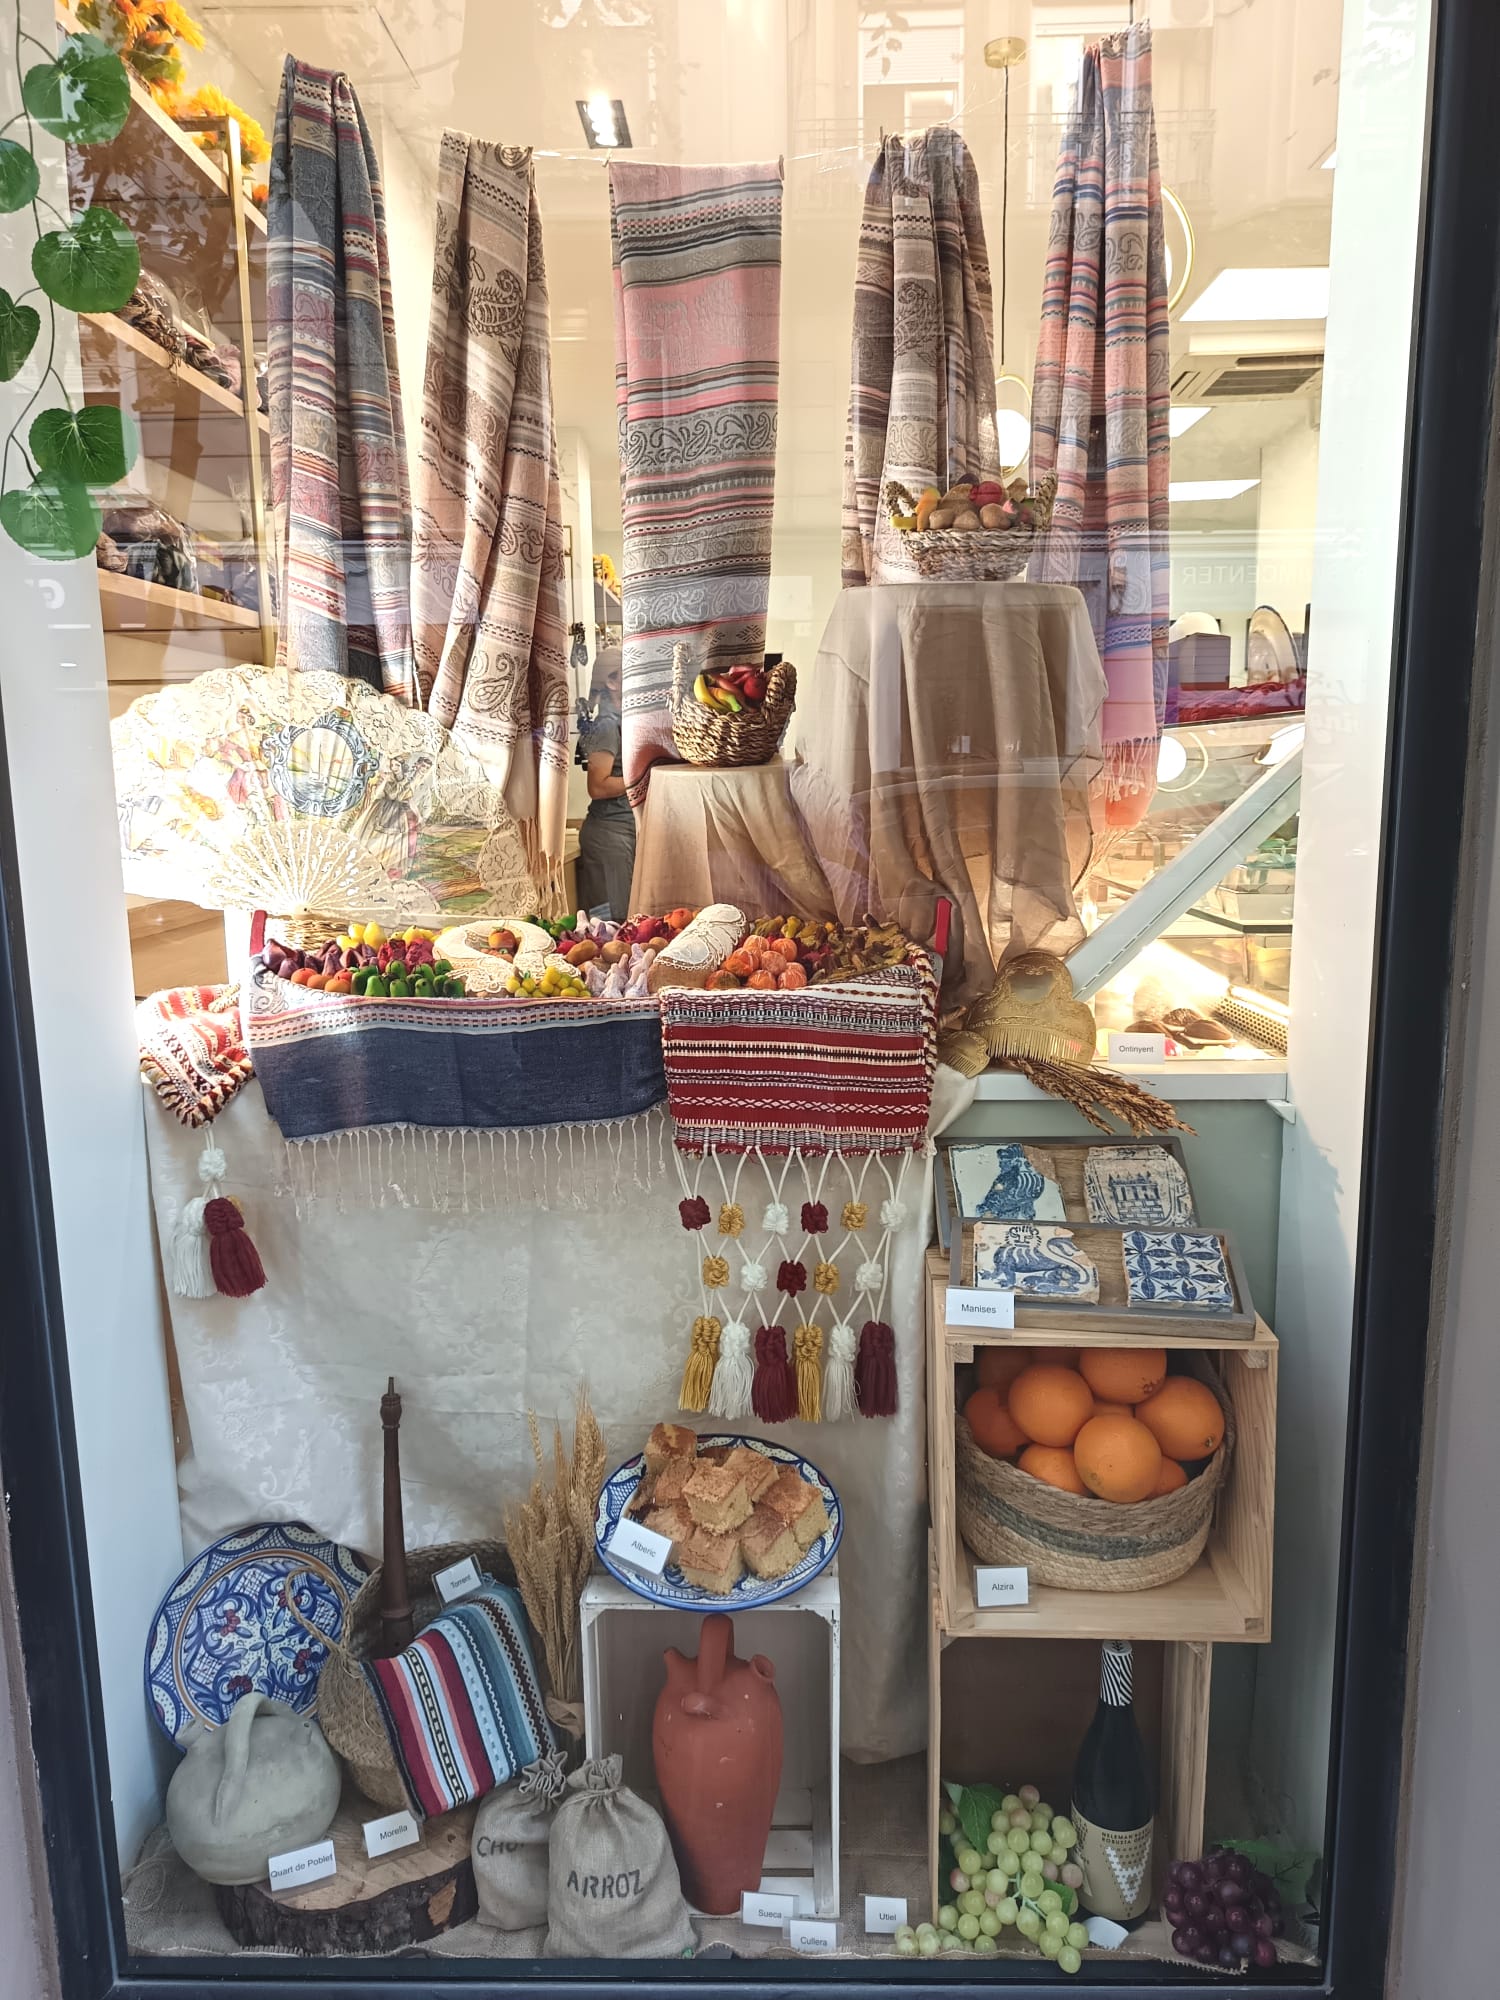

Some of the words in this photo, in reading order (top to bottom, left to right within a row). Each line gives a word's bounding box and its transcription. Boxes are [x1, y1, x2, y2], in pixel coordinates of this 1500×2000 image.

[1119, 1045, 1154, 1054] Ontinyent
[961, 1303, 997, 1314] Manises
[631, 1539, 657, 1559] Alberic
[450, 1574, 472, 1589] Torrent
[991, 1583, 1015, 1591] Alzira
[379, 1825, 408, 1841] Morella
[476, 1836, 525, 1857] CHU
[270, 1865, 293, 1879] Quart
[295, 1861, 306, 1871] de
[307, 1853, 333, 1868] Poblet
[567, 1869, 644, 1899] ARROZ
[758, 1909, 782, 1919] Sueca
[879, 1912, 897, 1921] Utiel
[800, 1936, 828, 1947] Cullera
